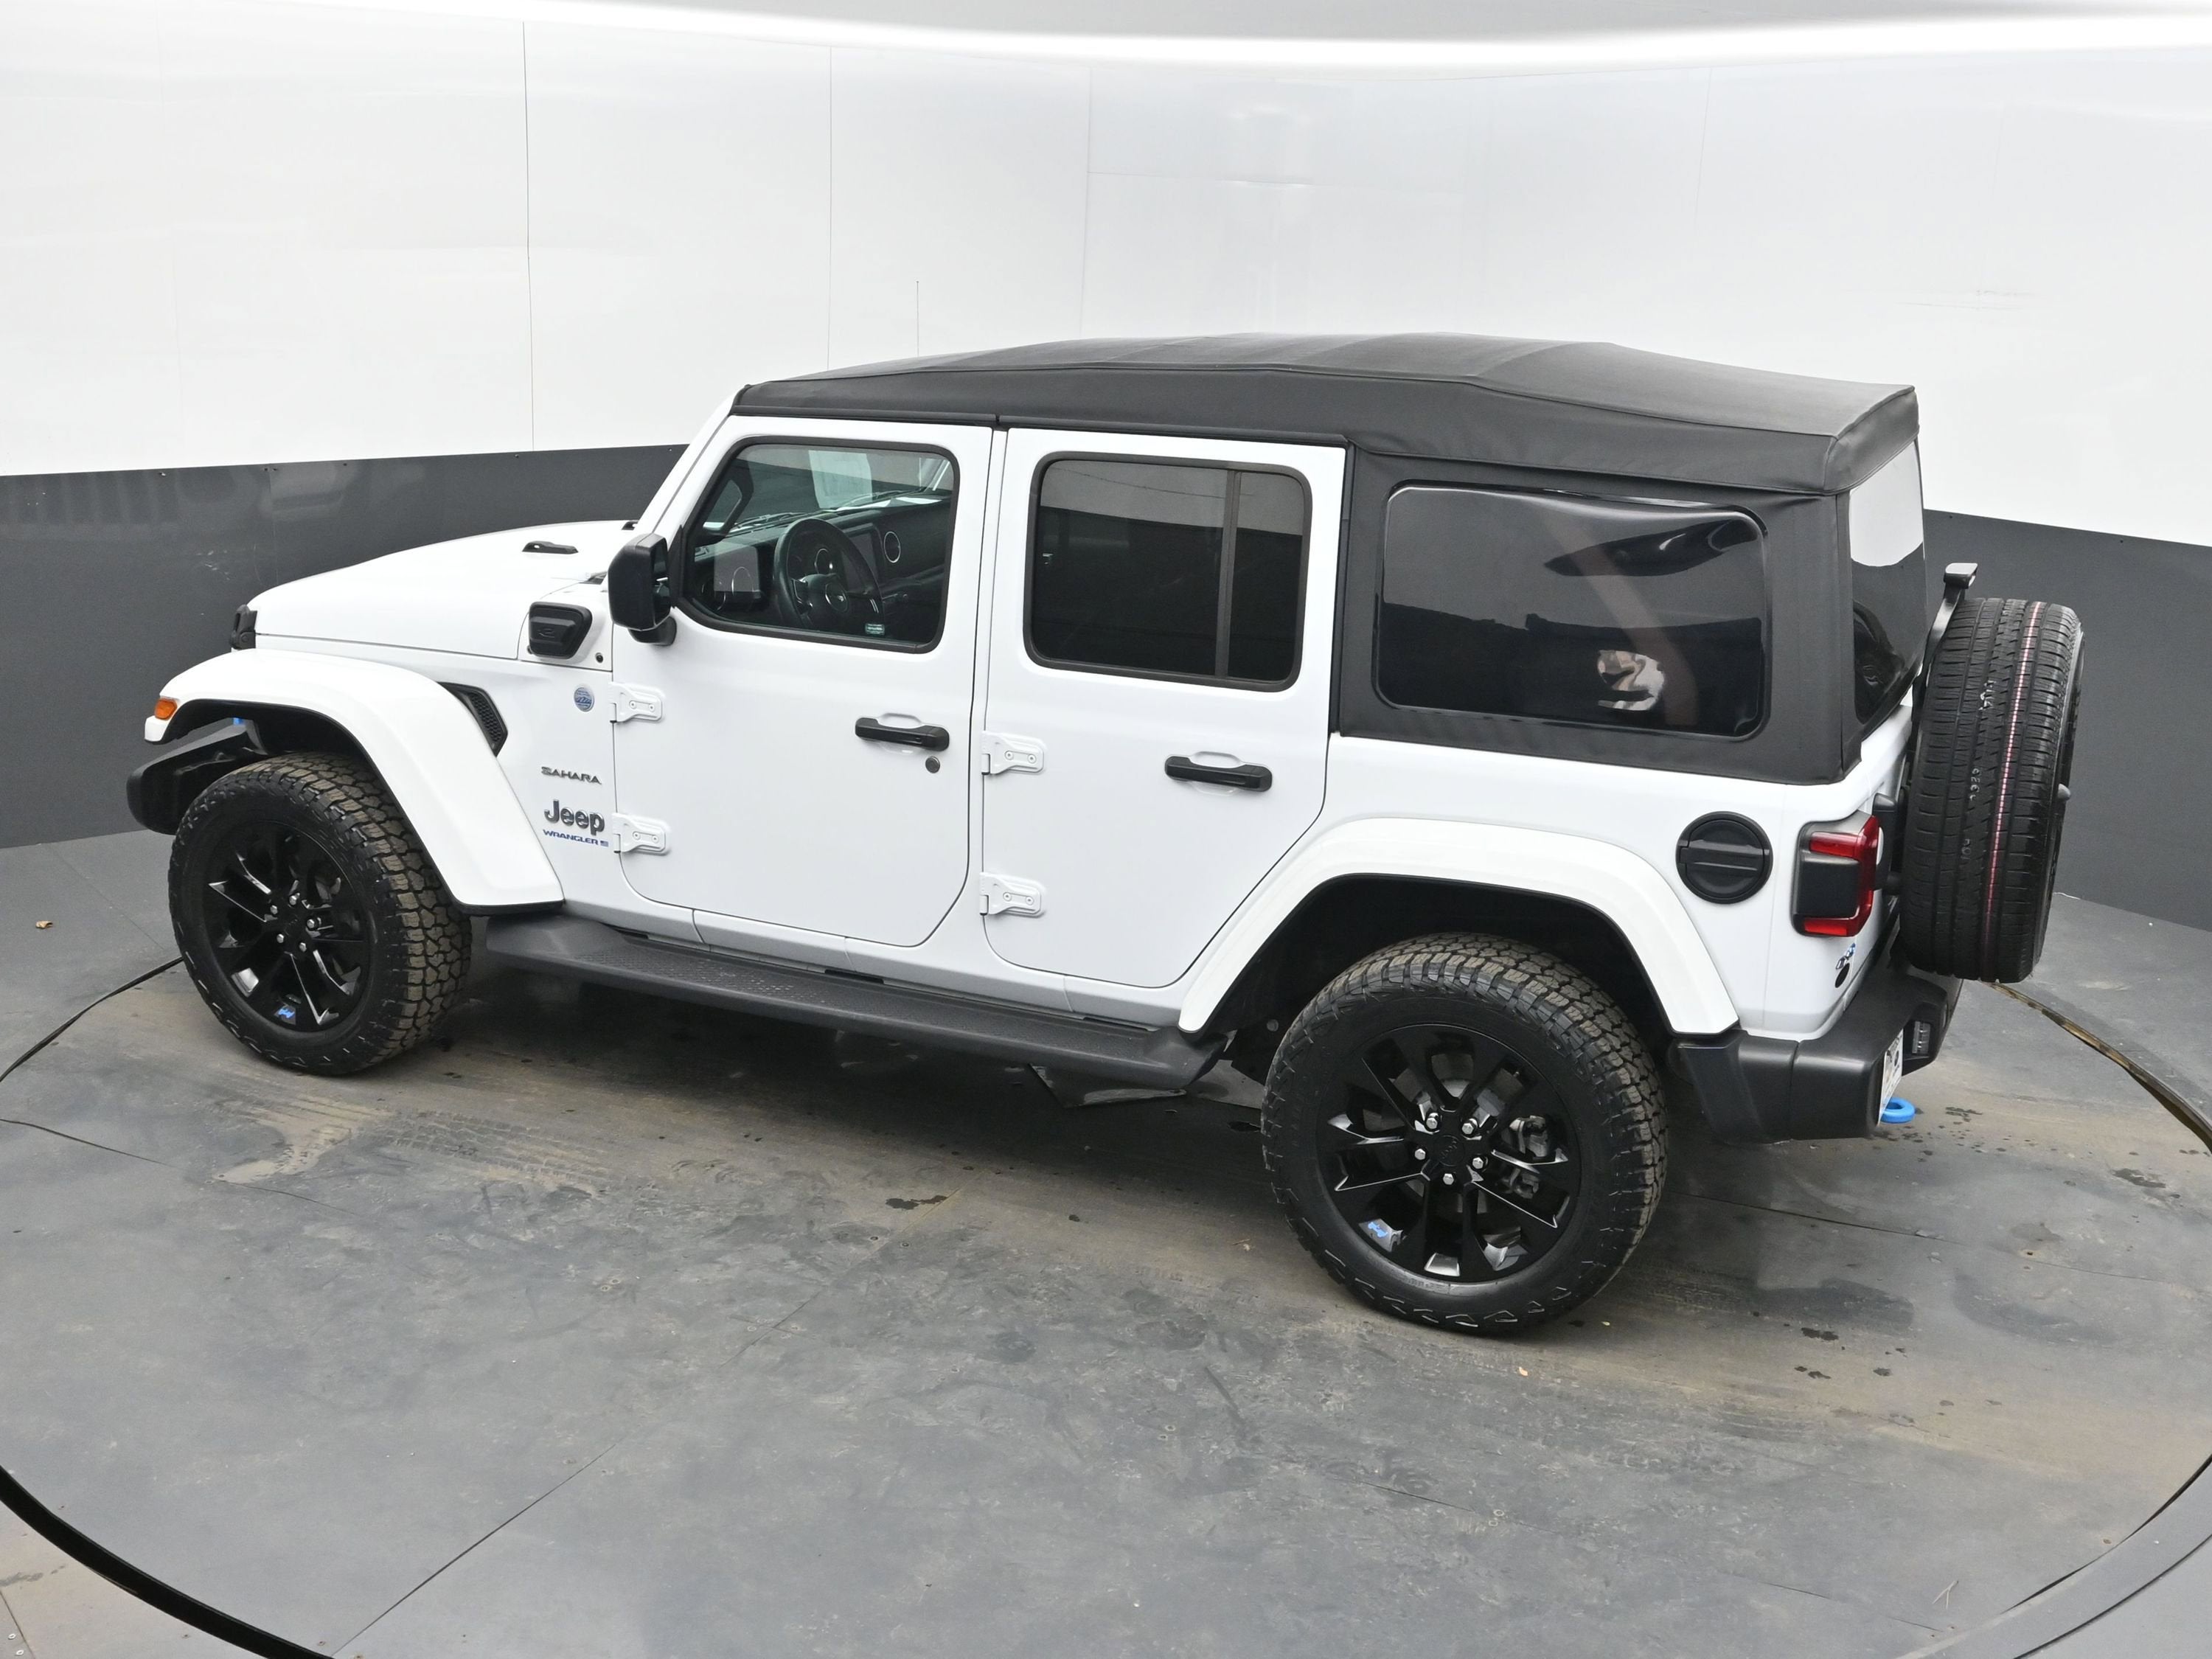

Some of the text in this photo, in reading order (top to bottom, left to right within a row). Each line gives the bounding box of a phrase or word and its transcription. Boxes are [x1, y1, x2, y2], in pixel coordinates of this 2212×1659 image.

[540, 766, 602, 785] SAHARA
[543, 799, 605, 836] Jeep
[542, 829, 599, 845] WRANGLER
